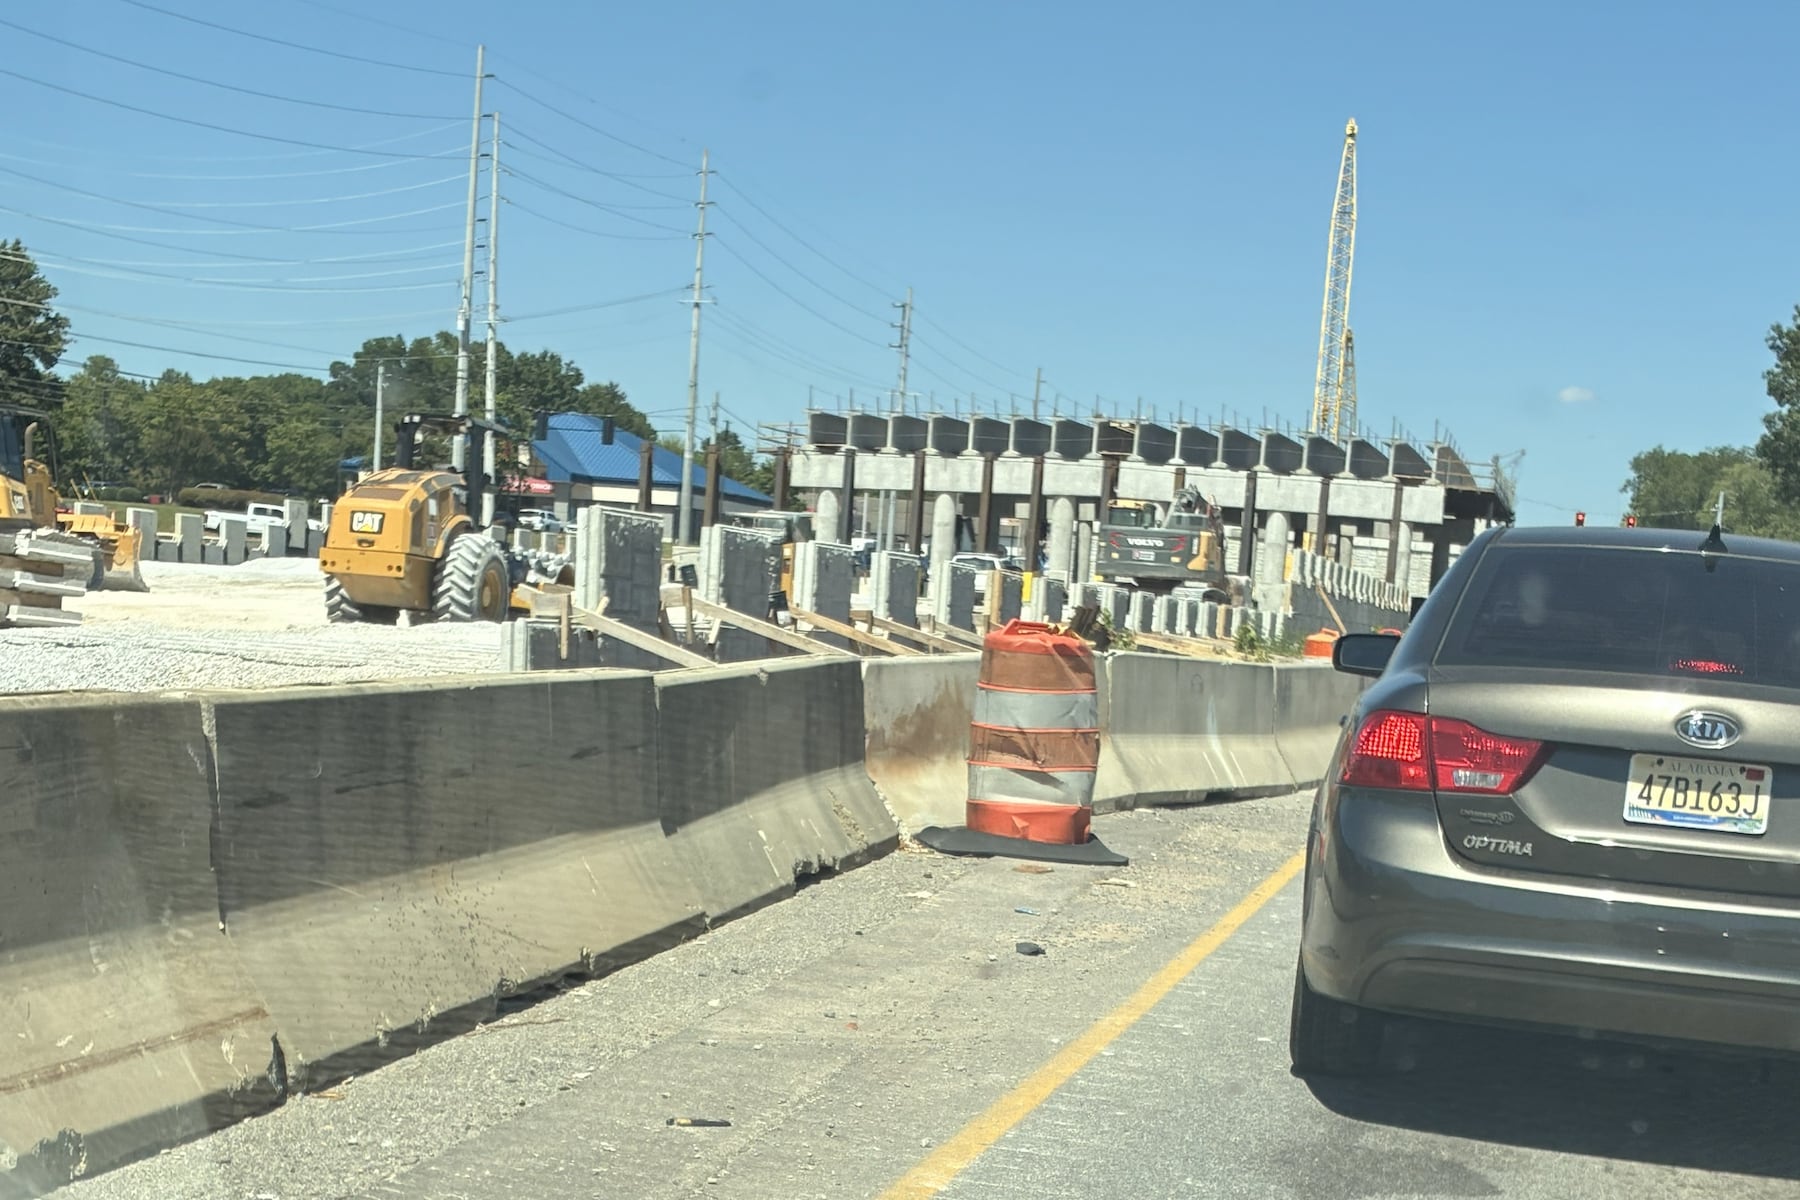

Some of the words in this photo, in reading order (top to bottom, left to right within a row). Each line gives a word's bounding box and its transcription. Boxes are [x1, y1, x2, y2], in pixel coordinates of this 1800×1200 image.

[352, 512, 383, 532] CAT
[1126, 537, 1165, 547] VOLVO
[1688, 719, 1727, 740] KIA
[1637, 773, 1761, 816] 47B163J
[1463, 835, 1533, 856] OPTIMA
